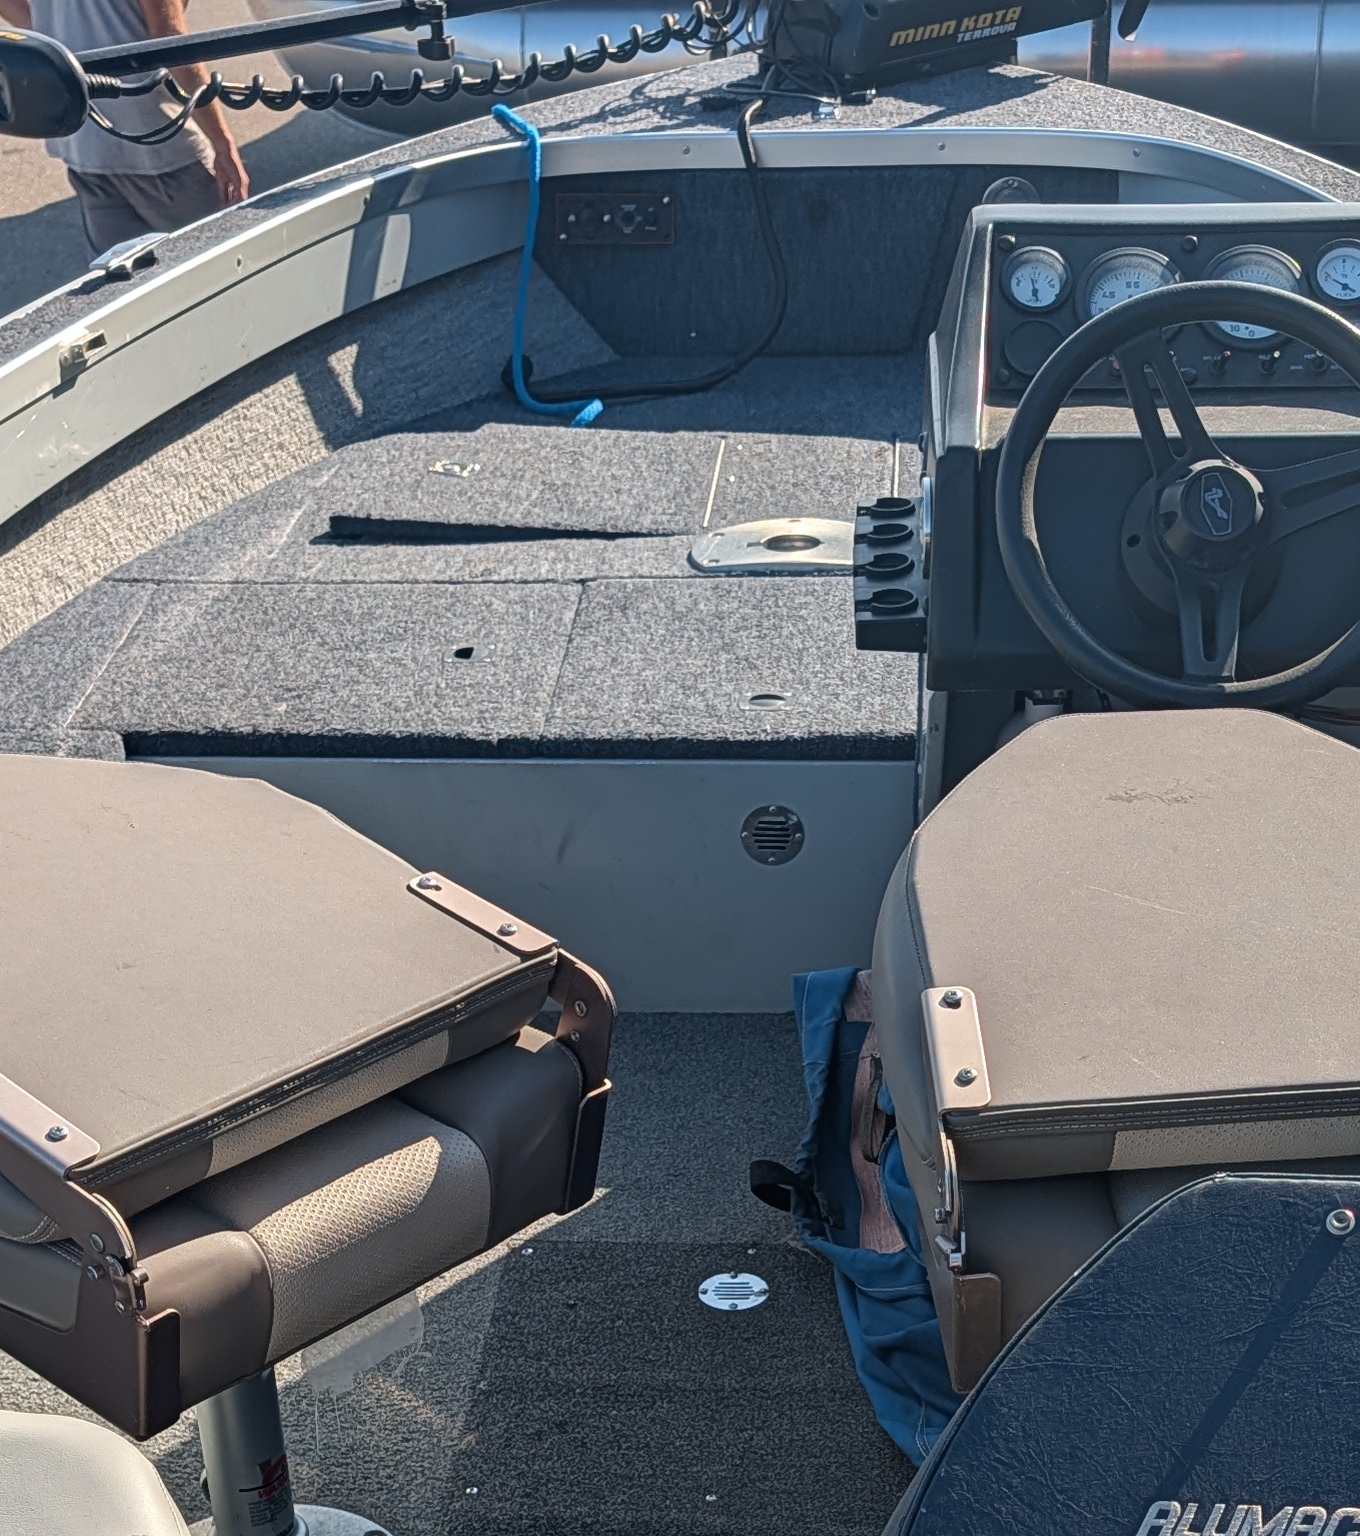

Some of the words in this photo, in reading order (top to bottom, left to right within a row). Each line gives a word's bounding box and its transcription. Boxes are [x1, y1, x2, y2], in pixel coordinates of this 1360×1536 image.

[889, 19, 957, 47] MINN
[960, 5, 1023, 32] KOTA
[957, 21, 1017, 43] TERROVA
[1125, 281, 1140, 289] 55
[1102, 291, 1116, 299] 45
